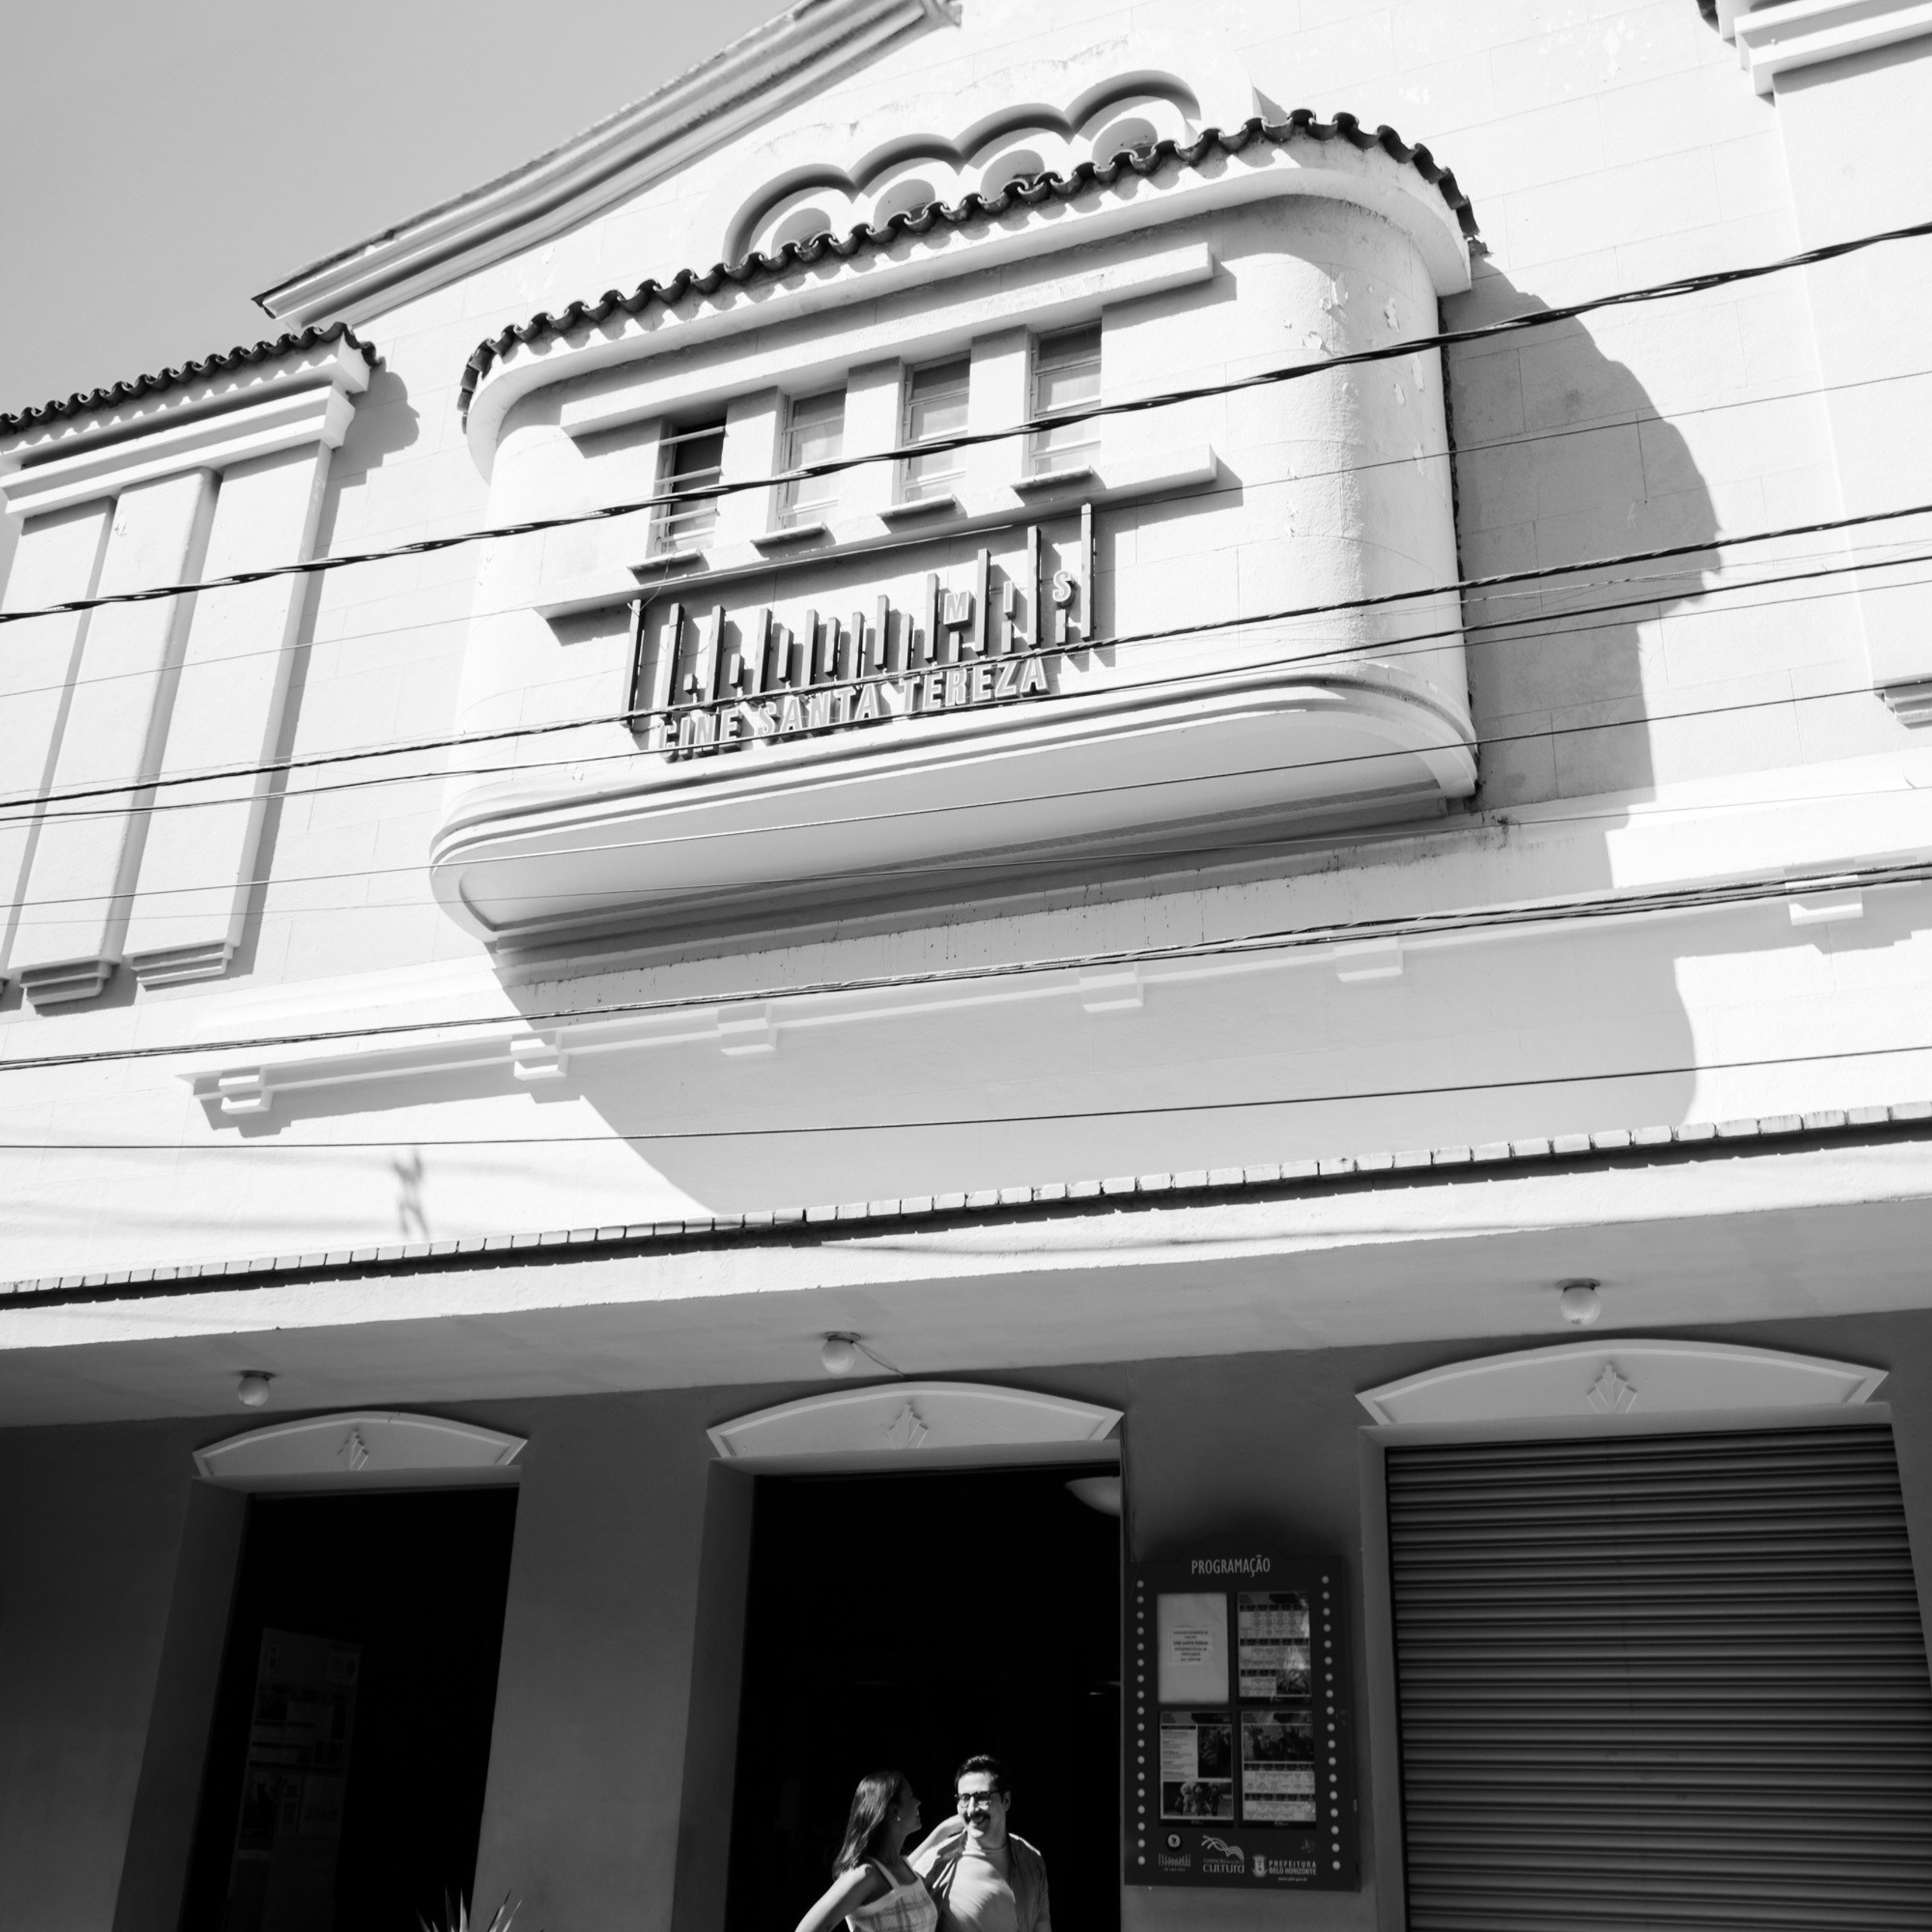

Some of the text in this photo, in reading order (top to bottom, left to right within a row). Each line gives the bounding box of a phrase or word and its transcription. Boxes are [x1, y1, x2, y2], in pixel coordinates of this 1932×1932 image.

[659, 657, 1050, 760] CINE SANTA TEREZA
[1191, 1555, 1271, 1577] PROGRAMAÇÃO
[1269, 1860, 1317, 1869] PREFEITURA
